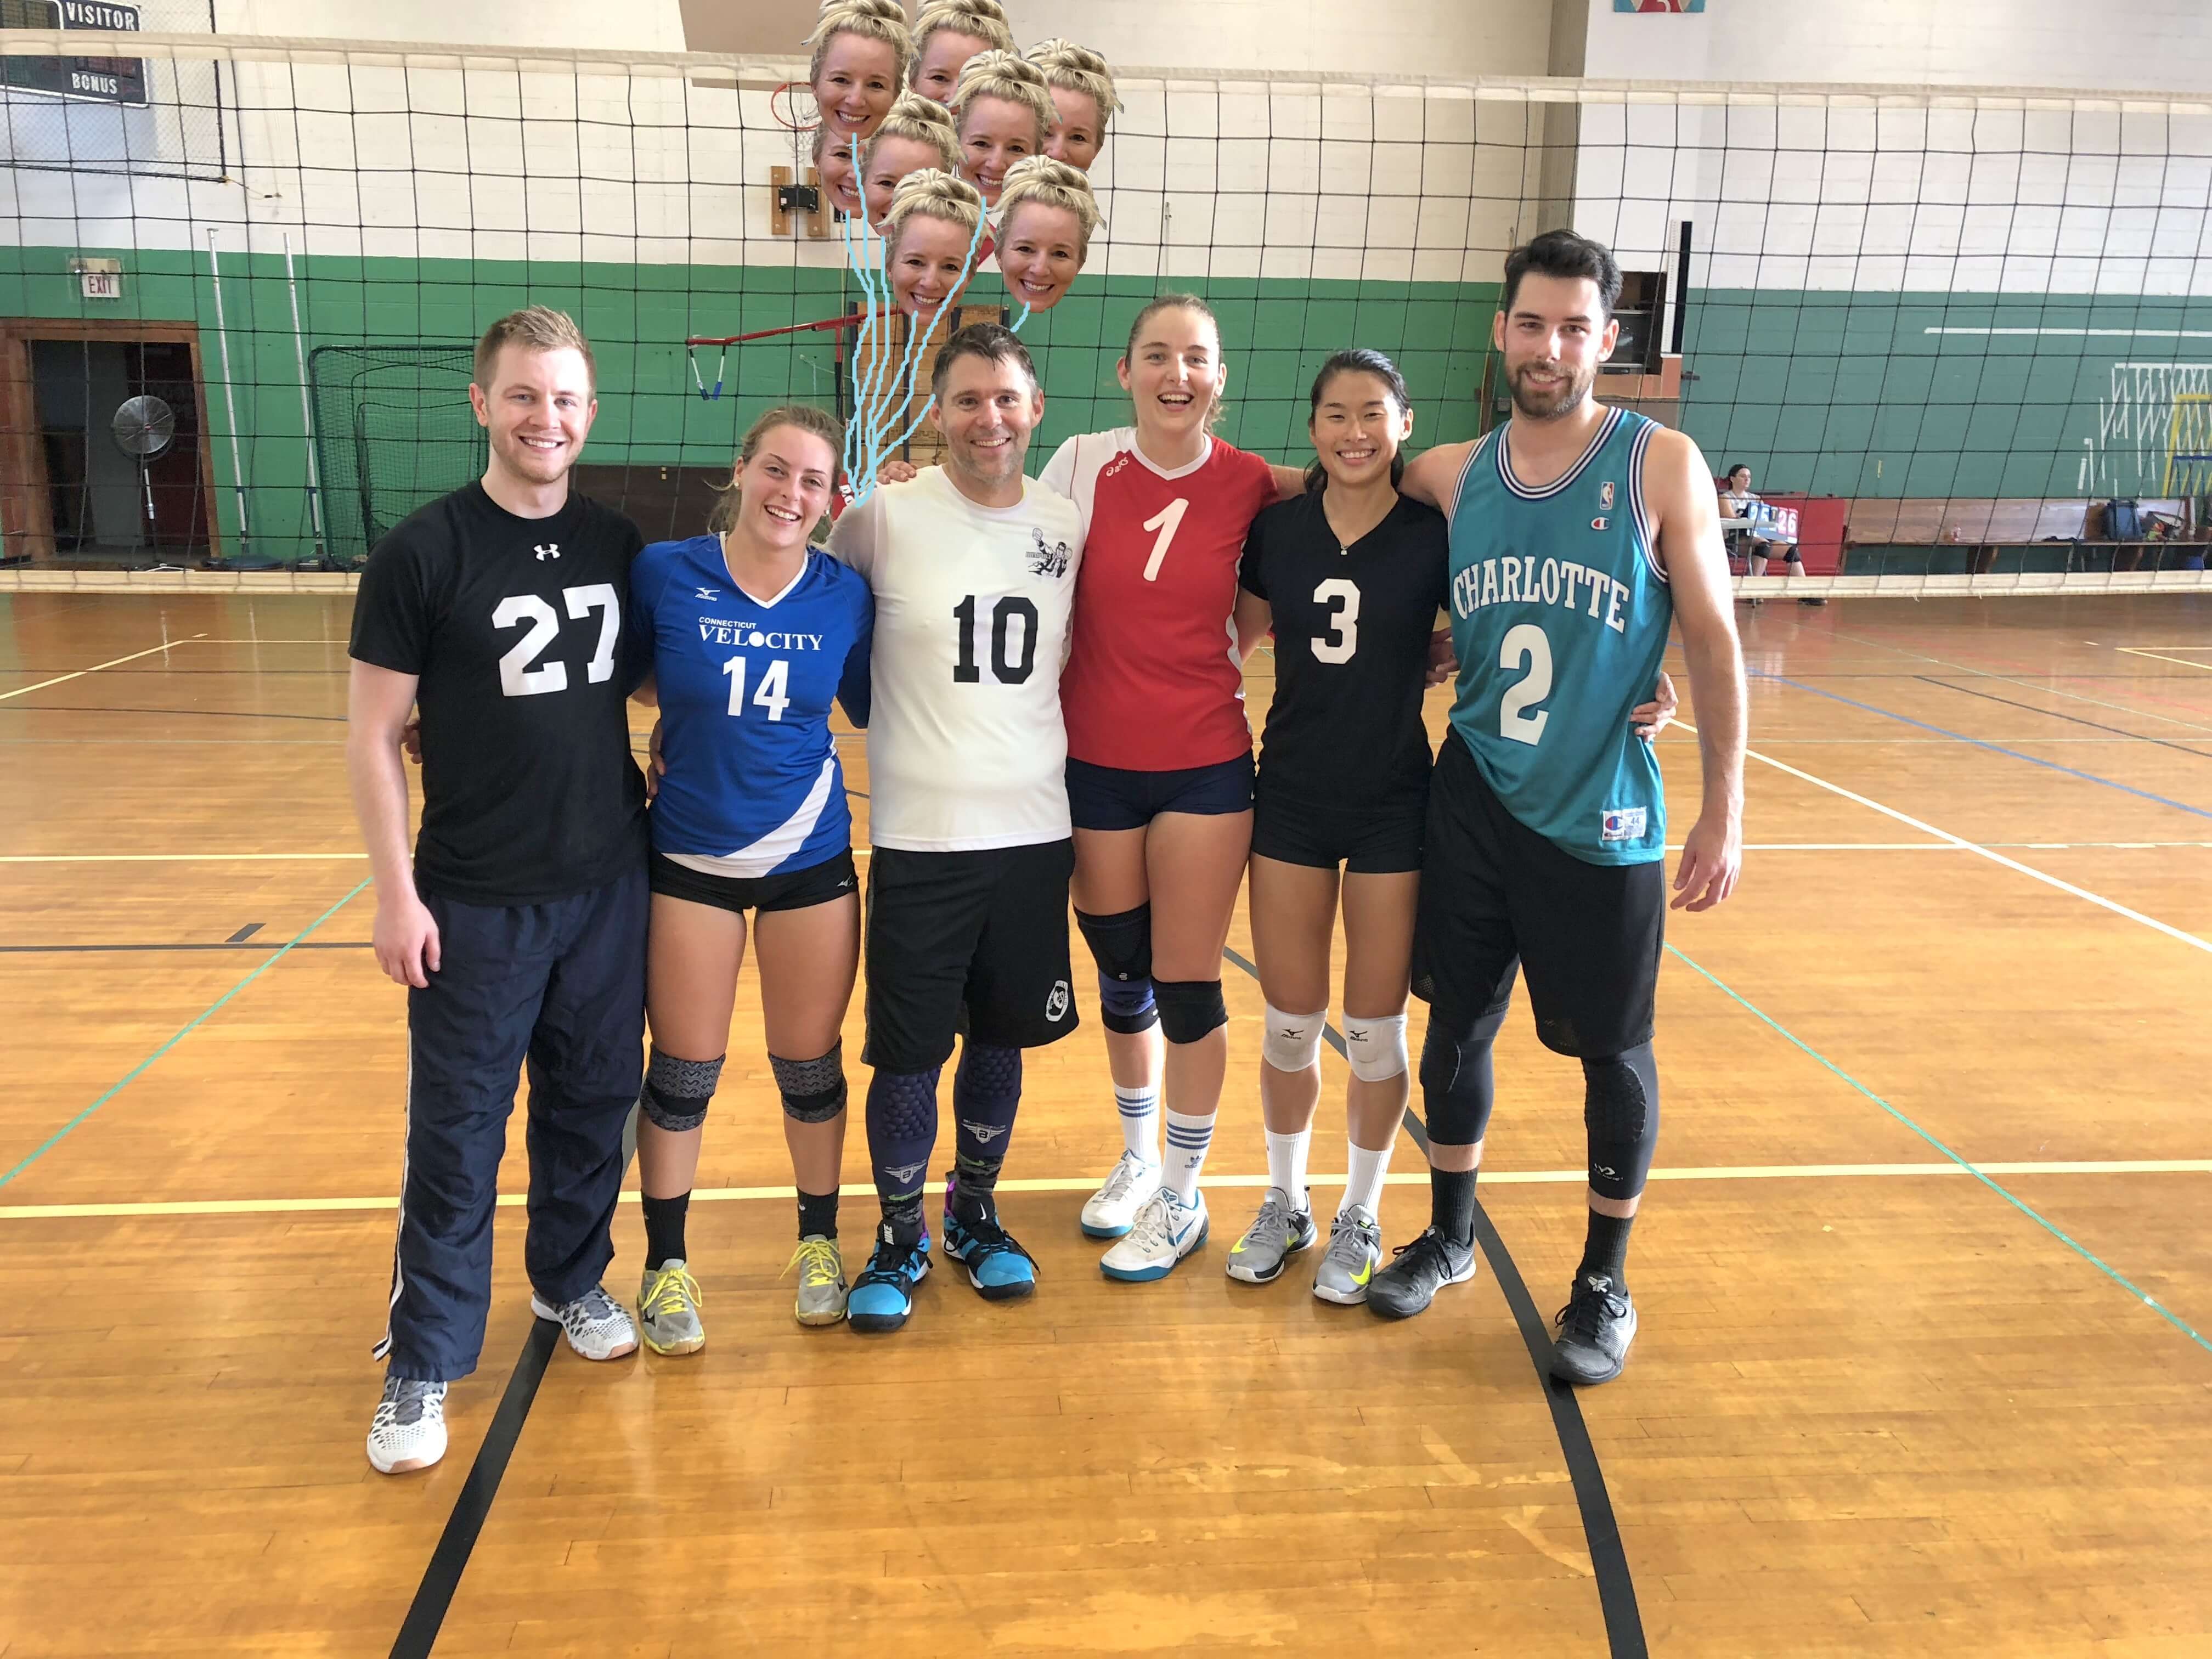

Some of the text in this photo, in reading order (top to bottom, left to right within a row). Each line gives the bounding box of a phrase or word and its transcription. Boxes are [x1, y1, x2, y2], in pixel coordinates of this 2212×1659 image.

[66, 2, 135, 31] VISITOR
[71, 72, 118, 94] BONUS
[88, 275, 112, 294] EXIT
[1143, 498, 1189, 582] 1
[1778, 510, 1797, 534] 26
[1453, 556, 1630, 634] CHARLOTTE
[492, 583, 620, 697] 27
[698, 617, 757, 629] CONNECTICUT
[698, 624, 823, 651] VELOCITY
[953, 595, 1038, 684] 10
[1311, 578, 1361, 664] 3
[723, 656, 791, 721] 14
[1499, 623, 1553, 746] 2
[883, 1223, 895, 1245] NIKE
